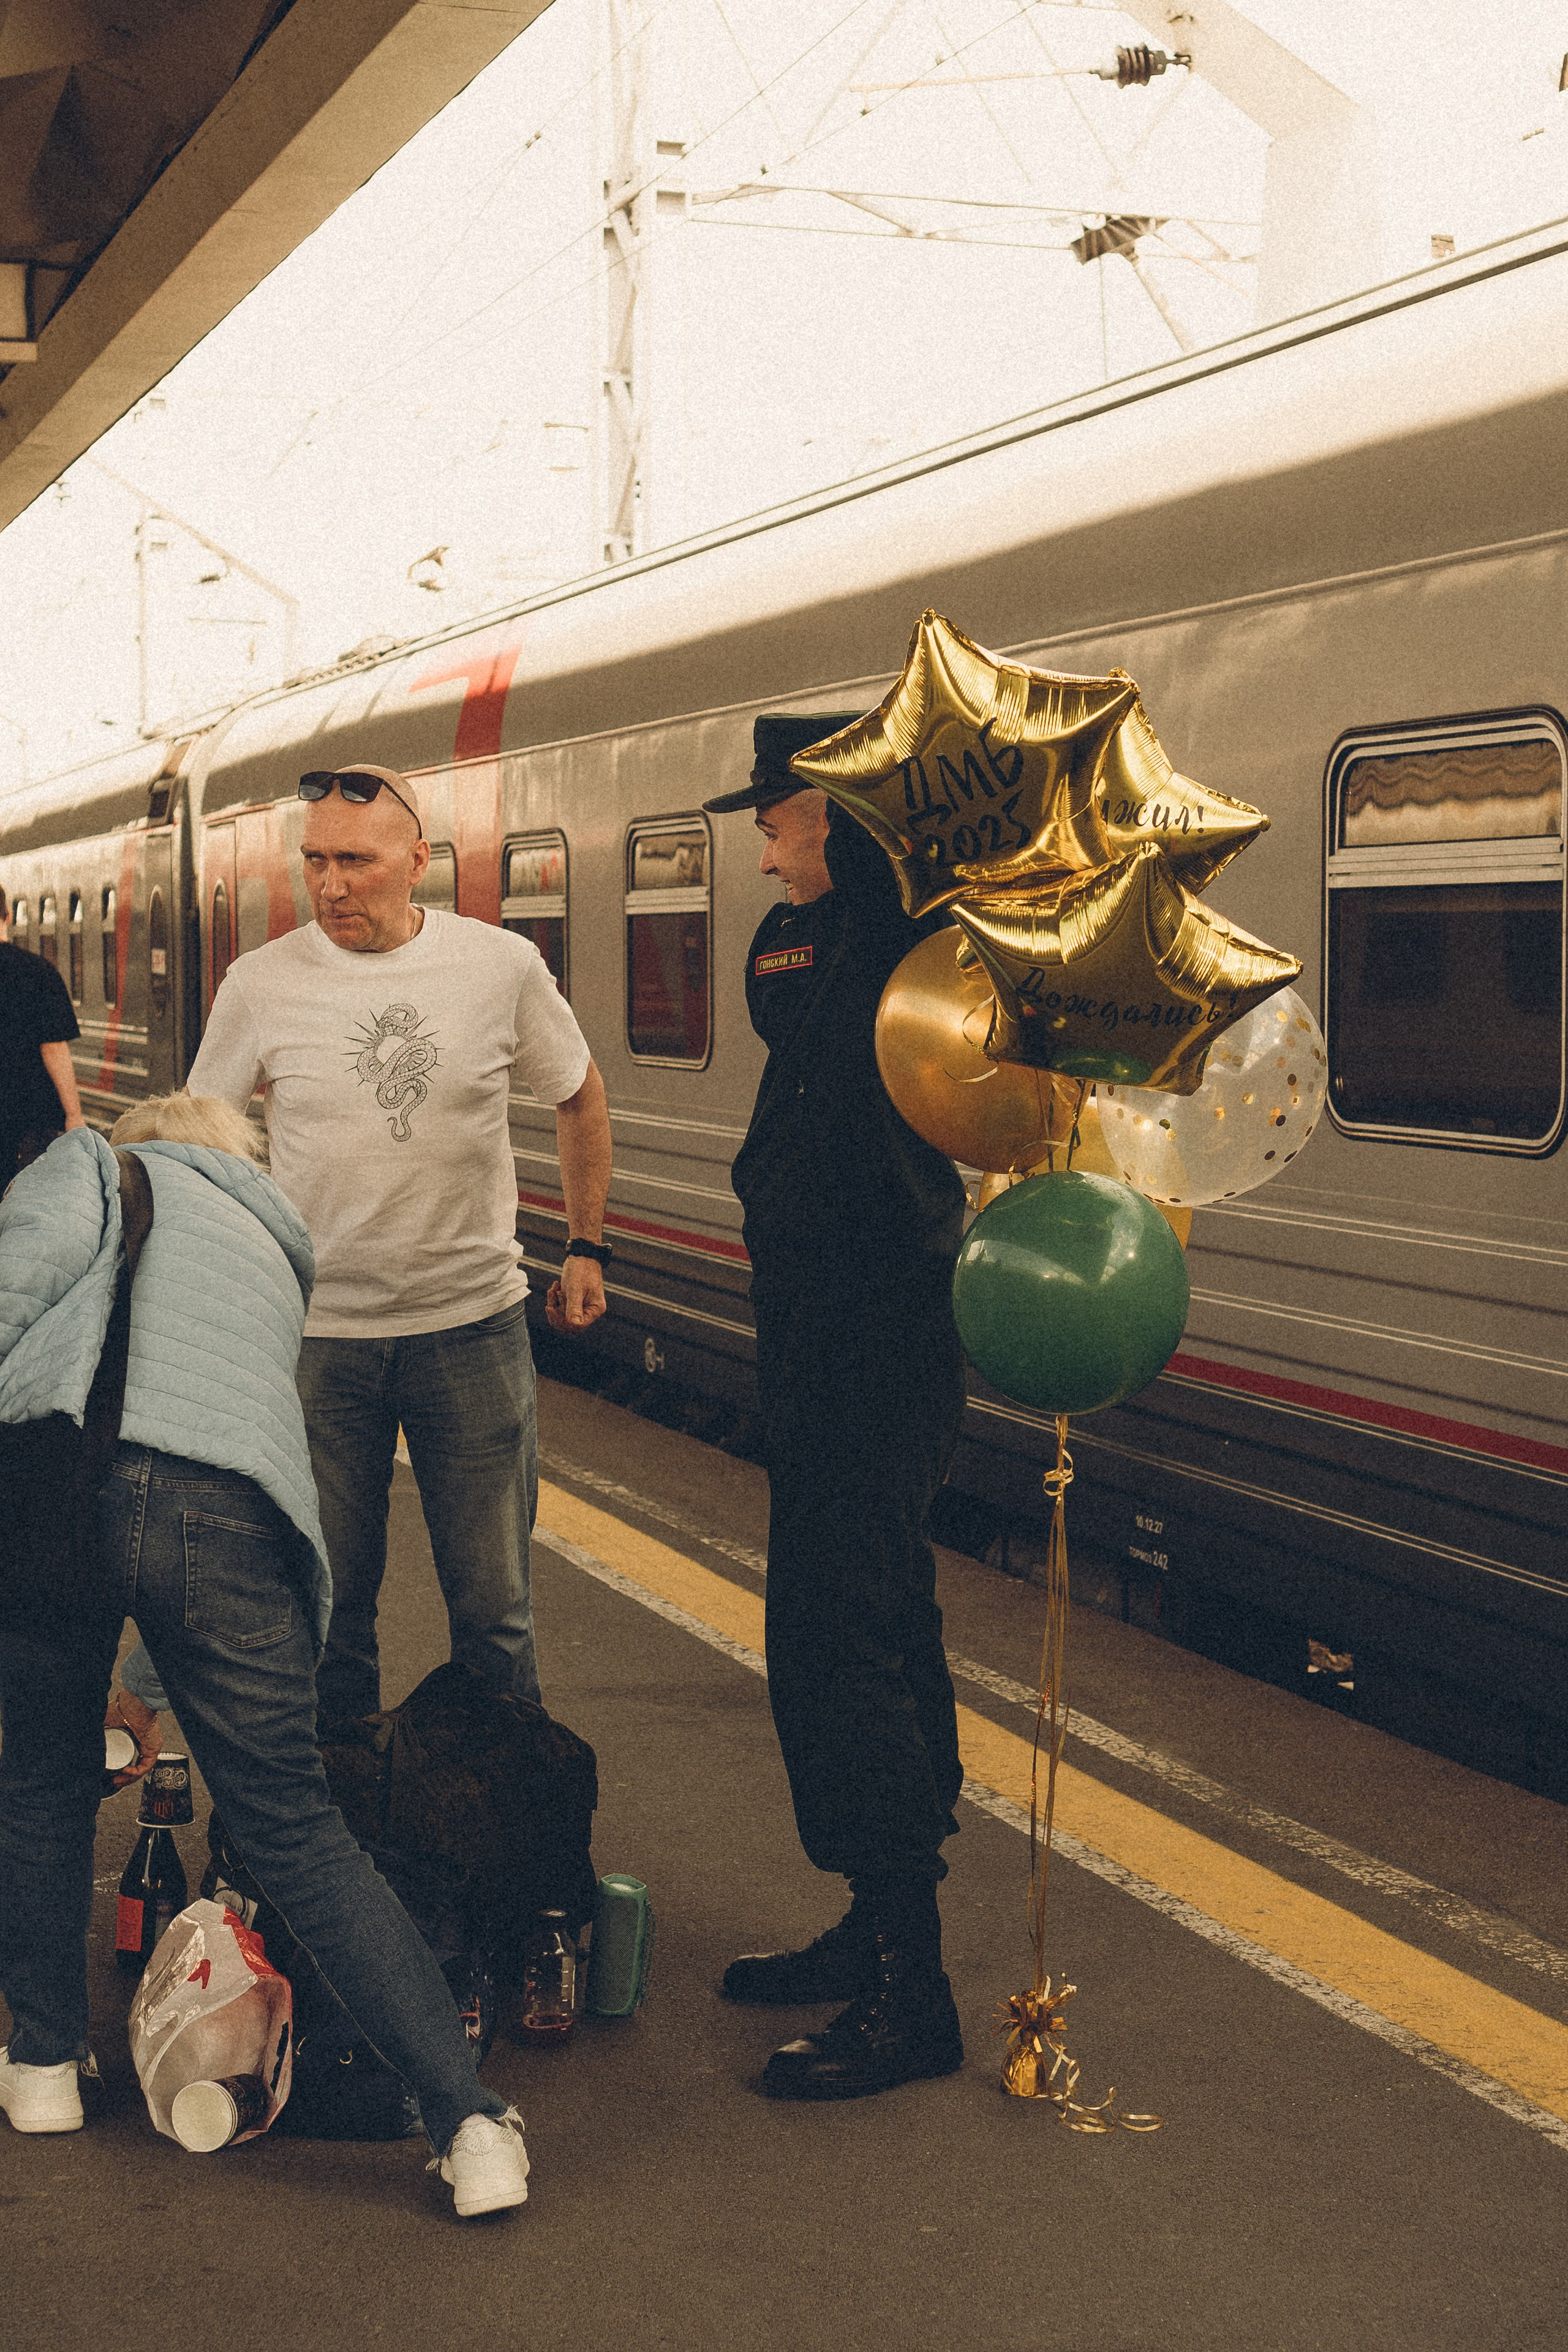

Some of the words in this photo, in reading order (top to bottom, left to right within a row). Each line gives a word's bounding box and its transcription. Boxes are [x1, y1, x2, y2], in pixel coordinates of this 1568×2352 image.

[903, 717, 1023, 835] ДМБ
[923, 789, 1031, 869] 2025
[759, 954, 788, 970] ГОНСКИЙ
[791, 952, 807, 964] М.А.
[1015, 966, 1236, 1031] Дождались!
[1153, 1550, 1168, 1570] 242
